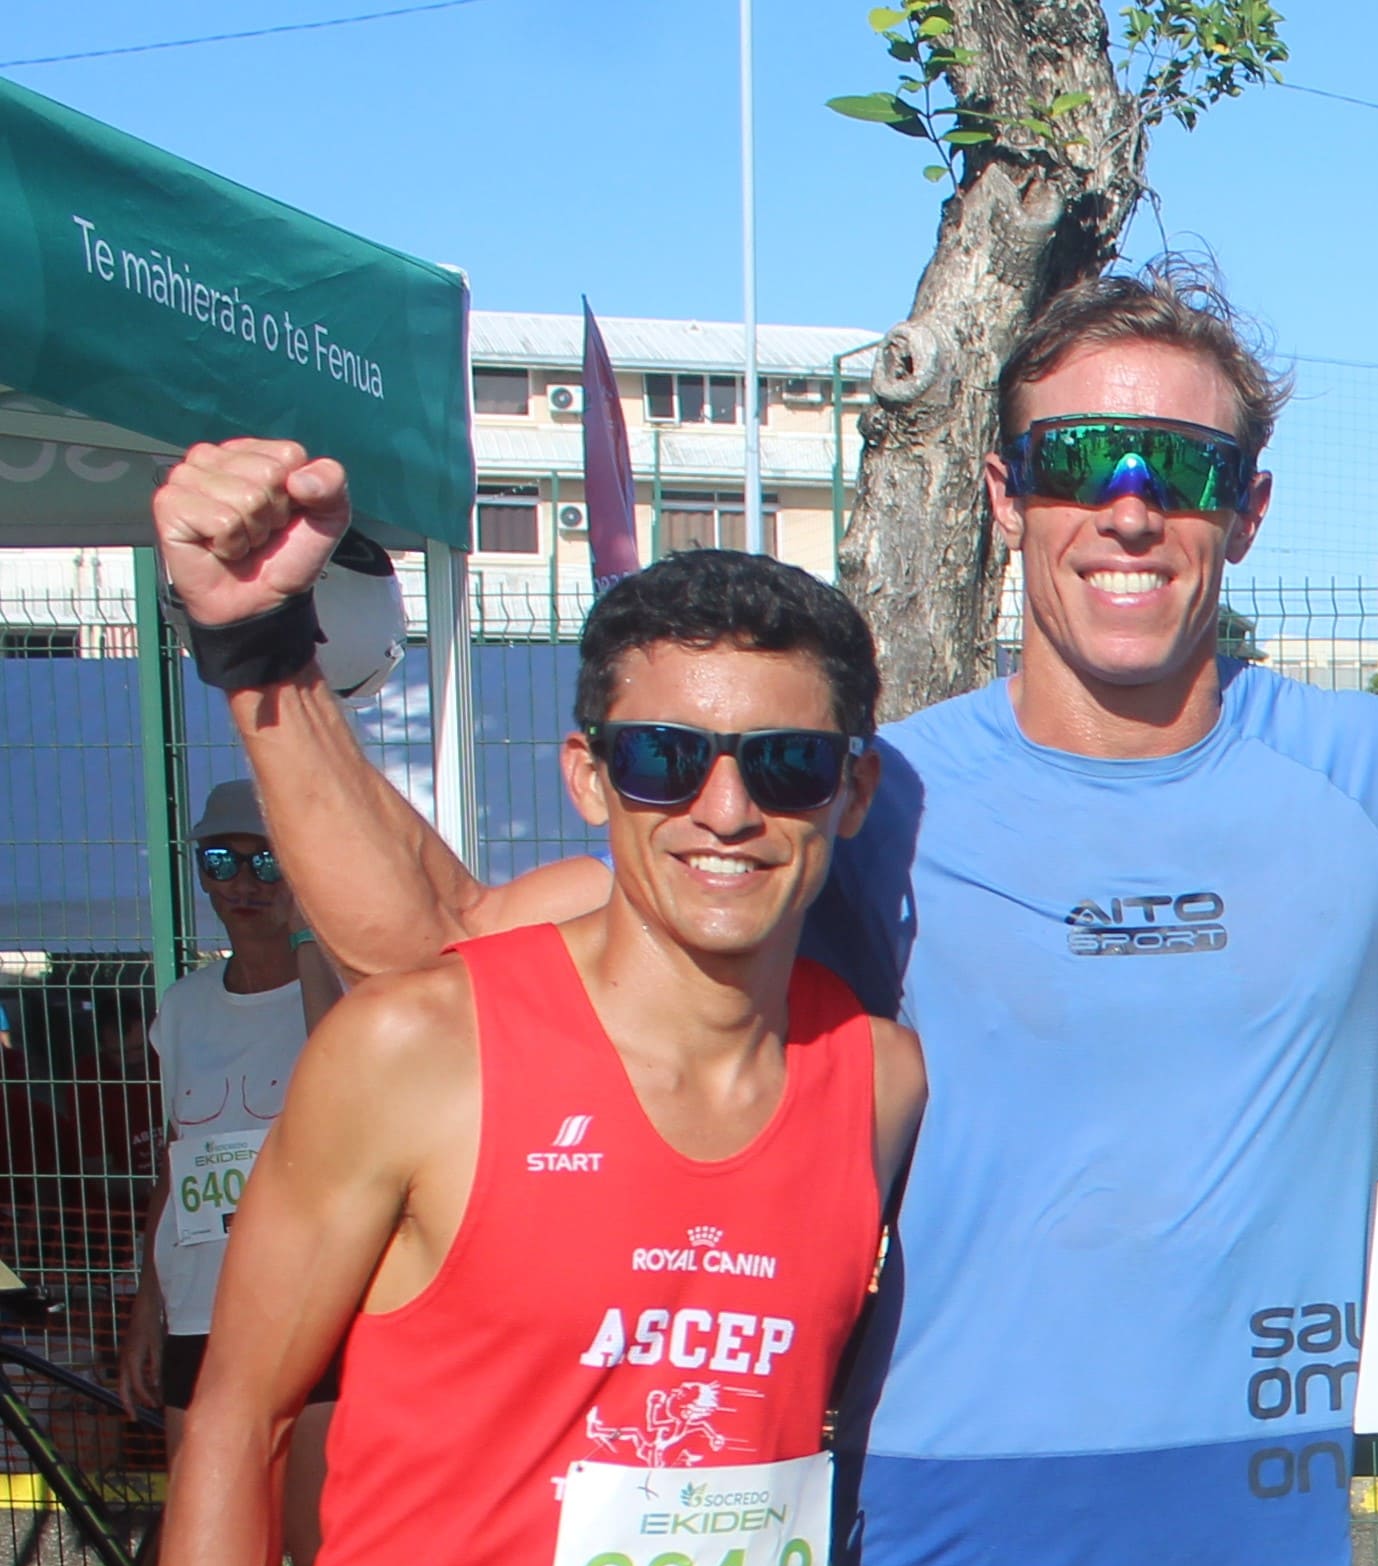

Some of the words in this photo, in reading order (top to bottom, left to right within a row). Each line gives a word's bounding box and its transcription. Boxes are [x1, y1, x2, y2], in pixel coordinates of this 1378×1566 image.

[72, 214, 115, 281] Te
[263, 312, 279, 351] o
[284, 311, 308, 365] te
[313, 322, 384, 400] Fenua
[1064, 891, 1224, 925] AITO
[1068, 929, 1226, 951] SPORT
[526, 1152, 604, 1172] START
[632, 1247, 698, 1271] ROYAL
[703, 1249, 776, 1279] CANIN
[578, 1307, 795, 1376] ASCEP
[1247, 1361, 1360, 1421] om
[1247, 1441, 1347, 1499] on
[705, 1490, 769, 1507] SOCREDO
[639, 1504, 788, 1535] EKIDEN
